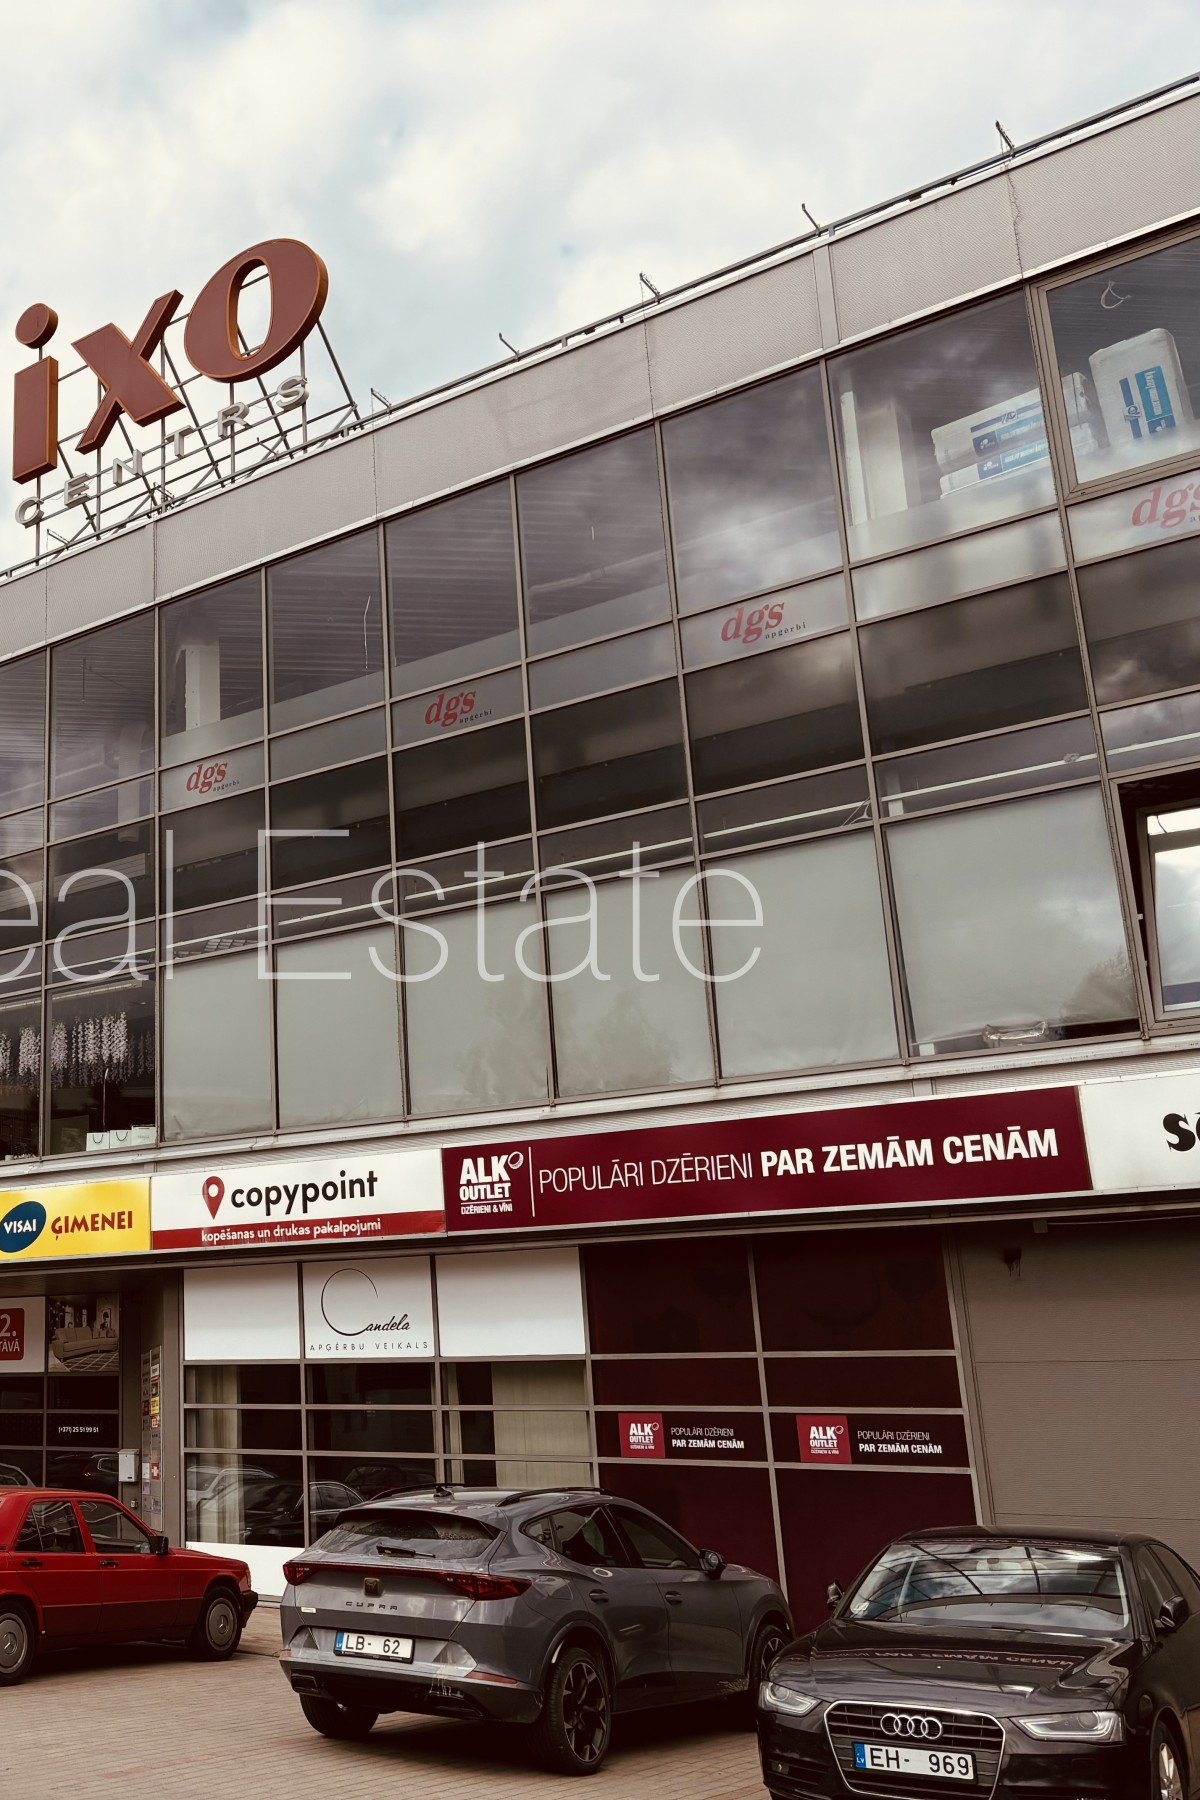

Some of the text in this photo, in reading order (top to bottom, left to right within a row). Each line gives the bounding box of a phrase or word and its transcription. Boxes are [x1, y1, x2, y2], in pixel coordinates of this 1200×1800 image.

[13, 238, 329, 484] ixo
[15, 375, 310, 529] CENTRS
[721, 602, 785, 645] dgs
[425, 690, 477, 727] dgs
[186, 762, 228, 794] dgs
[538, 1127, 1060, 1194] POPULĀRI DZĒRIENI PAR ZEMĀM CENĀM
[231, 1170, 378, 1217] copypoint
[459, 1182, 511, 1201] OUTLET
[460, 1202, 513, 1215] DZĒRIENI & VĪNI
[3, 1219, 37, 1235] VISAI
[51, 1210, 134, 1242] ĢIMENEI
[201, 1217, 382, 1243] kopēšanas un drukas pakalpojumi
[0, 1313, 17, 1338] 2.
[309, 1341, 429, 1352] APĢĒRBU VEIKALS
[629, 1435, 654, 1443] OUTLET
[671, 1427, 734, 1437] POPULĀRI DZĒRIENI
[857, 1430, 930, 1441] POPULĀRI DZĒRIENI
[672, 1438, 745, 1449] PAR ZEMĀM CENĀM
[810, 1439, 838, 1448] OUTLET
[859, 1442, 942, 1454] PAR ZEMĀM CENĀM
[345, 1601, 398, 1611] CUPRA
[382, 1638, 401, 1655] 62
[856, 1757, 865, 1765] LV
[928, 1753, 970, 1776] 969
